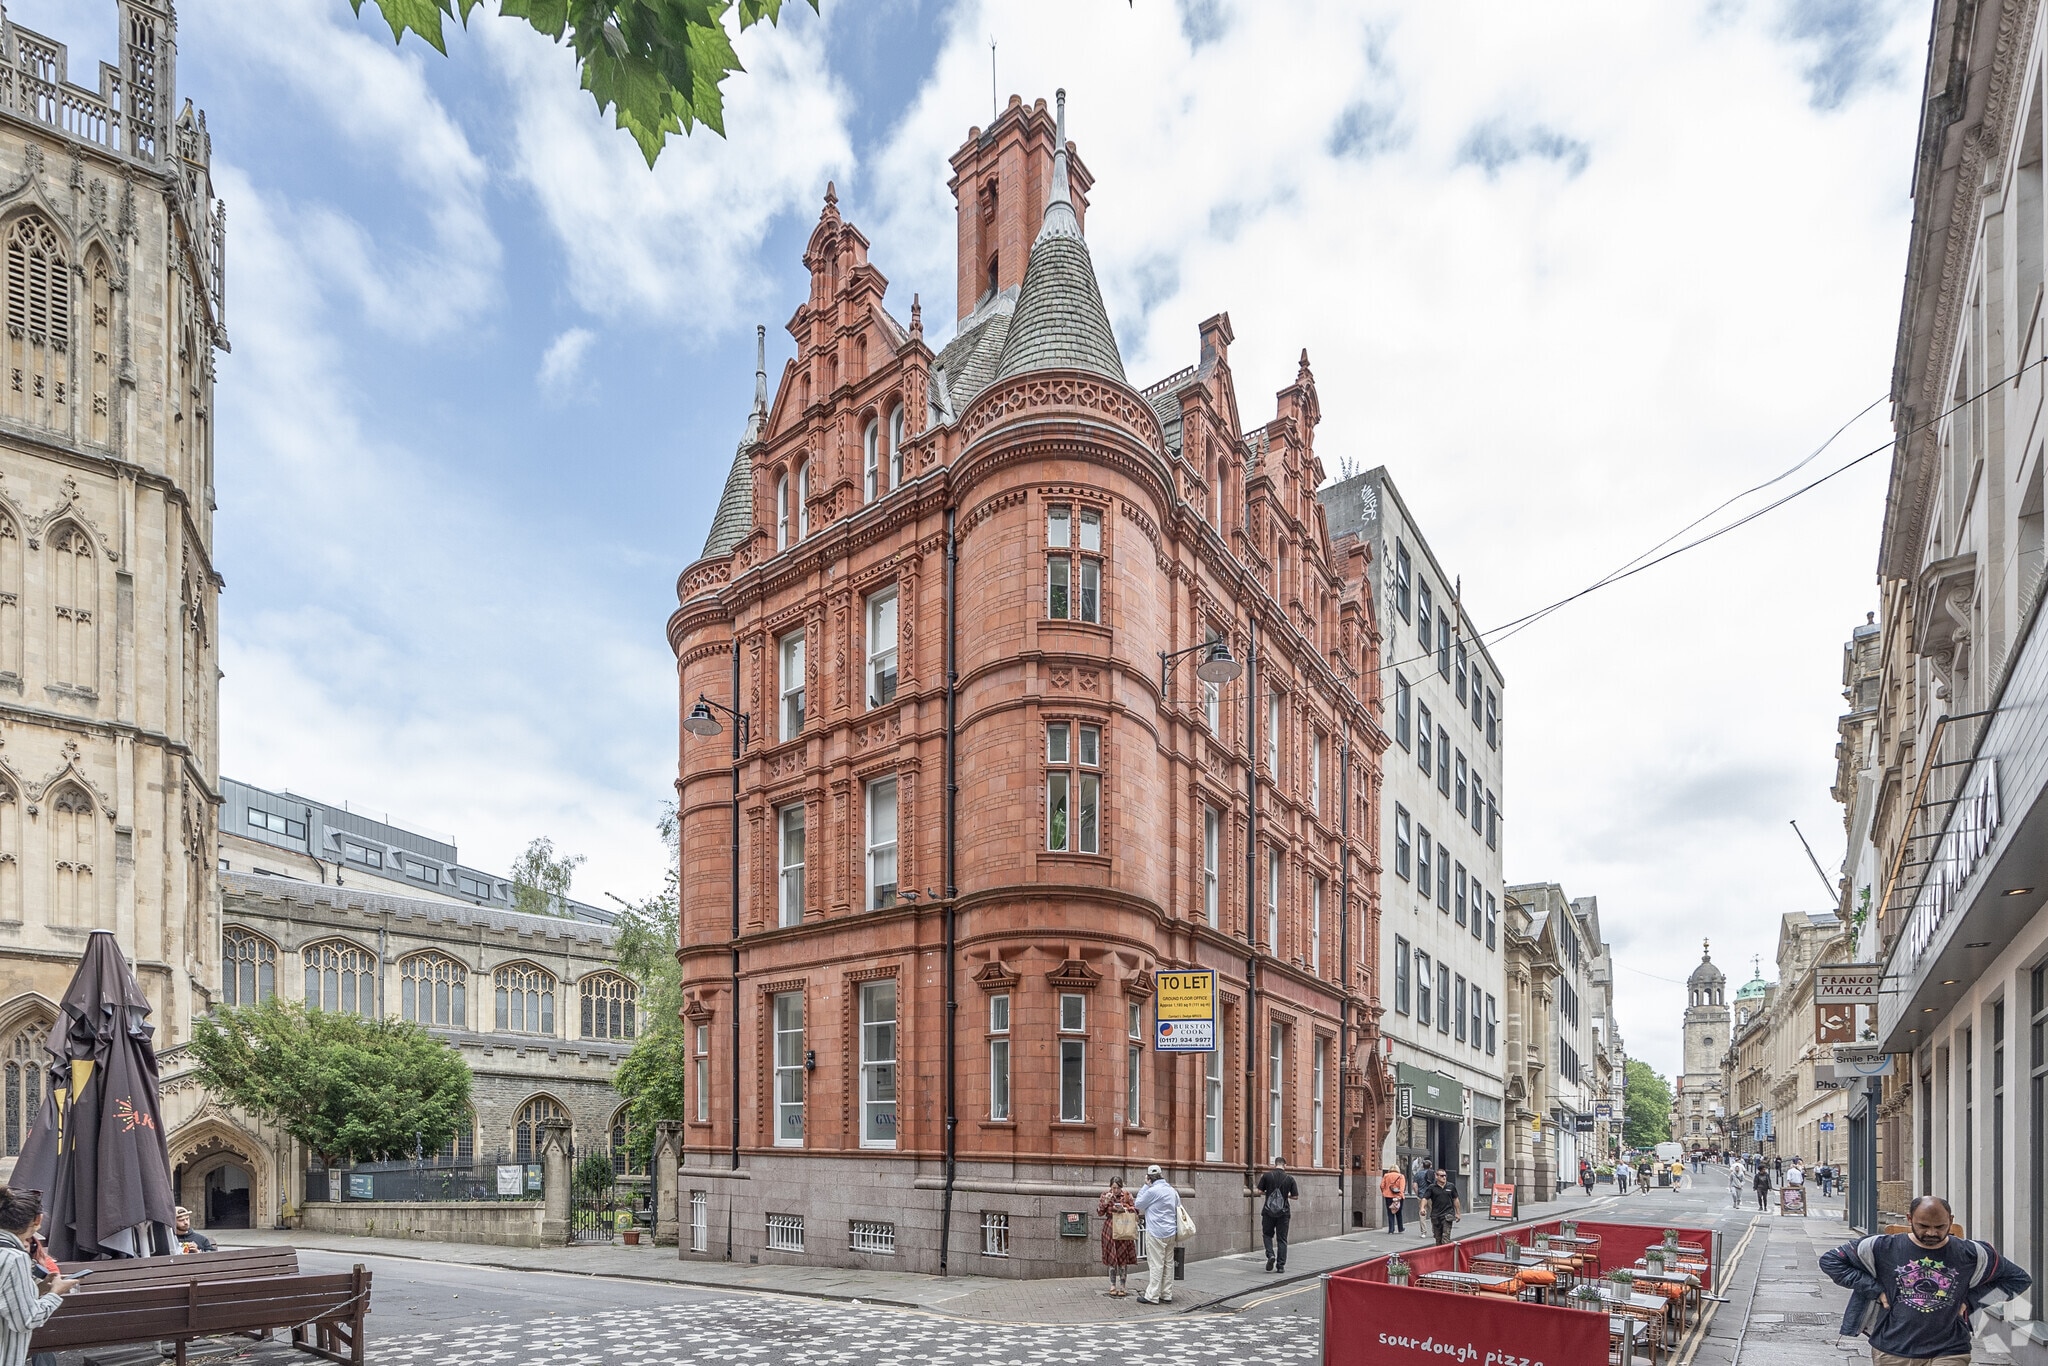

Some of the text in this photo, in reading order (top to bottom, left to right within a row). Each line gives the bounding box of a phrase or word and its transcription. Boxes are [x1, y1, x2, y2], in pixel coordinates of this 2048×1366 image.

[1946, 758, 2001, 912] MANCA
[1161, 976, 1208, 989] TO LET
[1821, 976, 1873, 985] FRANCO
[1822, 986, 1872, 995] MANCA
[1836, 1055, 1863, 1063] Smile
[1867, 1053, 1886, 1062] Pad
[1816, 1080, 1838, 1088] Pho
[1379, 1333, 1478, 1363] sourdough
